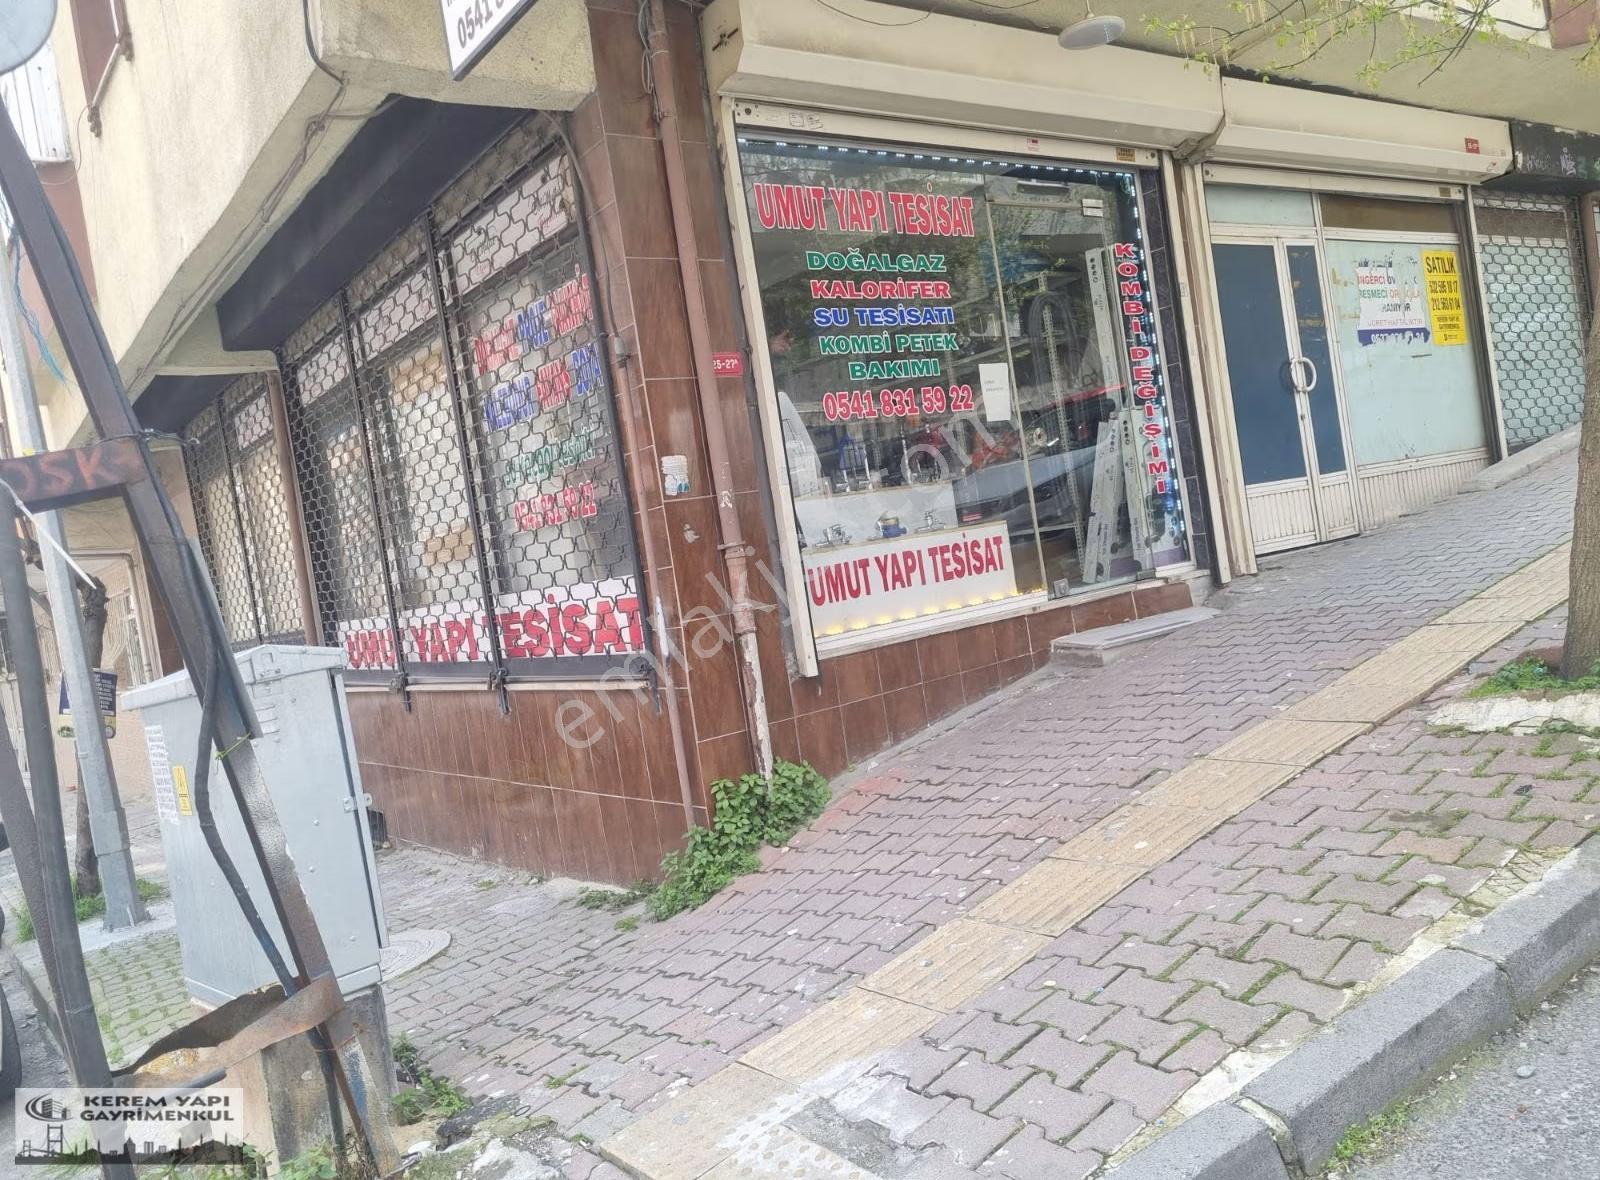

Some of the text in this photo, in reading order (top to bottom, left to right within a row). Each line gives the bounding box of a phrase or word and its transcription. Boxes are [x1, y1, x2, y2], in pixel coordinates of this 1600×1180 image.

[754, 182, 975, 237] UMUT YAPI TESİSAT
[806, 248, 947, 272] DOĞALGAZ
[1425, 256, 1456, 273] SATILIK
[810, 276, 952, 300] KALORİFER
[1114, 243, 1144, 334] KOMBİ
[814, 303, 955, 327] SU TESİSATI
[819, 330, 959, 355] KOMBİ PETEK
[848, 359, 941, 380] BAKIMI
[823, 390, 877, 421] 0541
[880, 388, 919, 416] 831
[921, 386, 946, 413] 59
[949, 384, 974, 412] 22
[807, 532, 1005, 606] UMUT YAPI TESİSAT
[410, 618, 479, 662] YAPI
